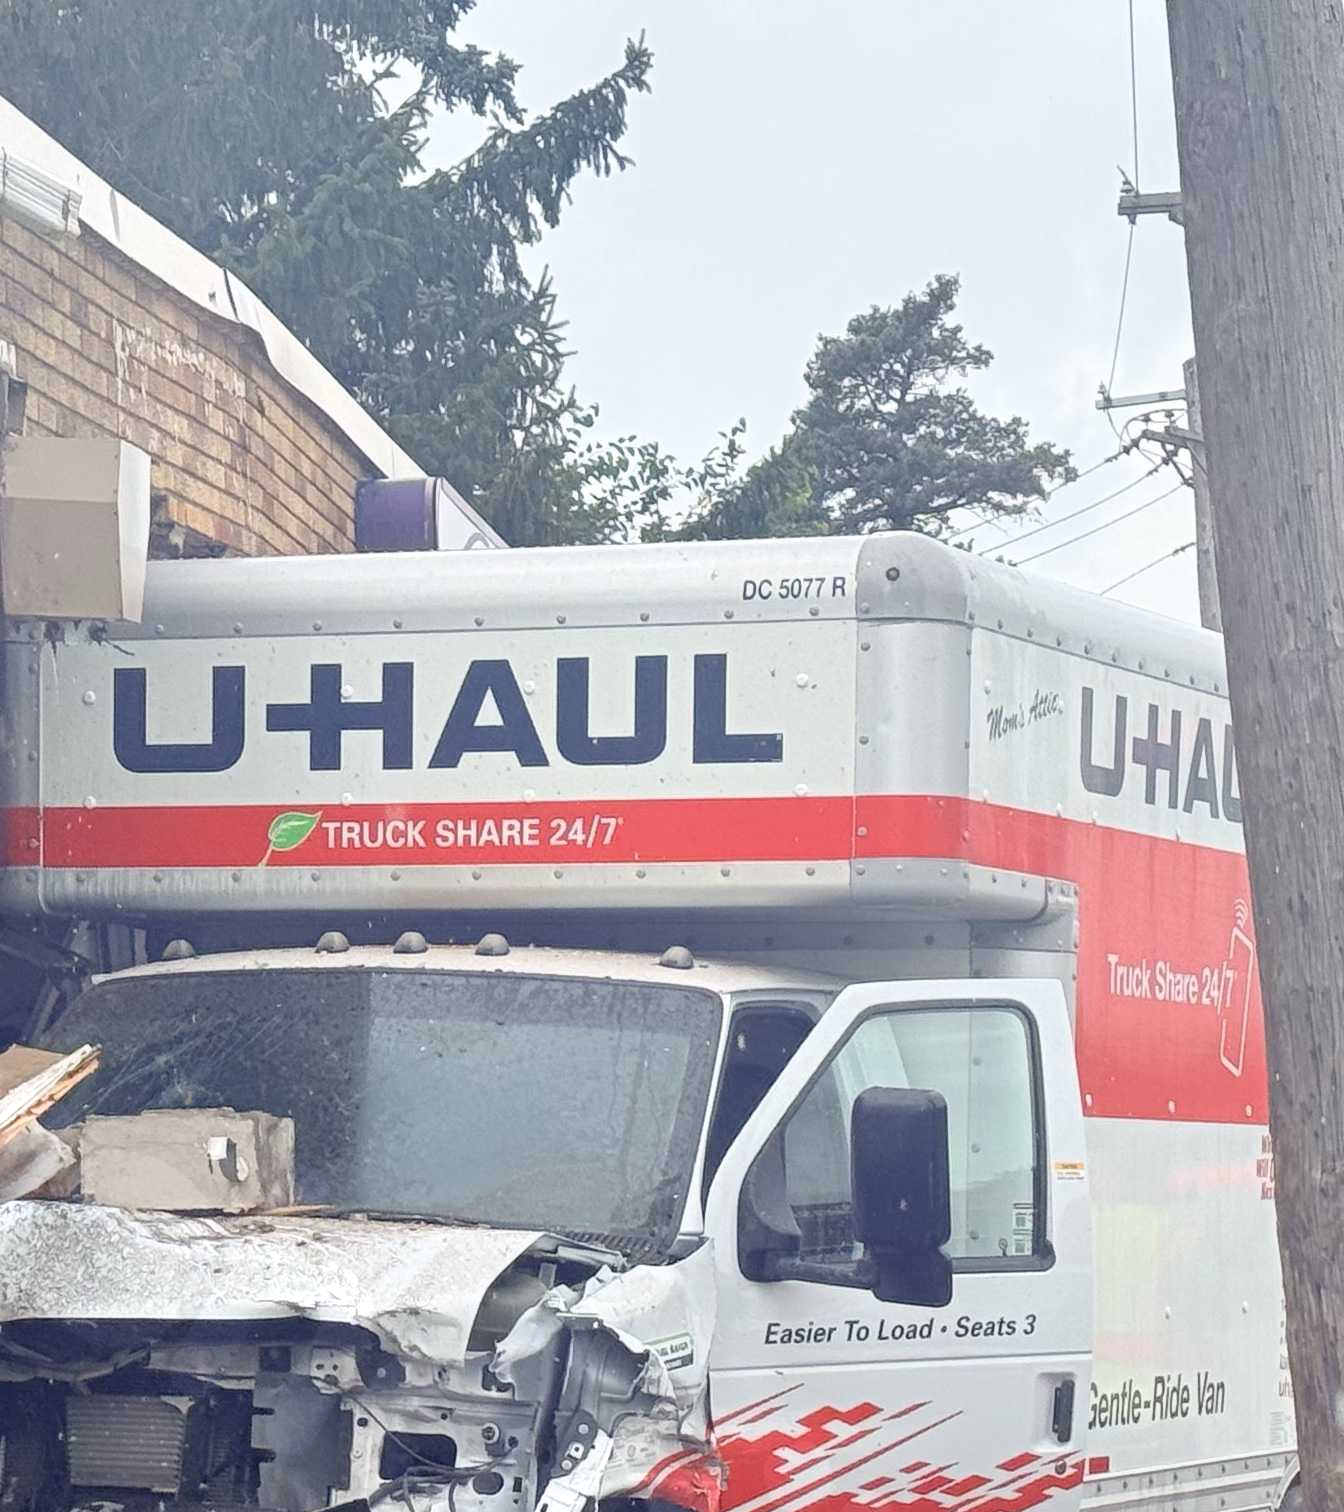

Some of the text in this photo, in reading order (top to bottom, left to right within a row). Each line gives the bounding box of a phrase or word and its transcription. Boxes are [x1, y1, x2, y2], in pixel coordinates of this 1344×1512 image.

[743, 576, 846, 600] DC 5077 R
[113, 653, 783, 773] U-HAUL
[987, 705, 1026, 742] Mom's
[322, 814, 617, 849] TRUCK SHARE 24/7
[1107, 953, 1235, 1015] Truck Share 24/7
[764, 1314, 1037, 1344] Easier To Load Seats 3
[1197, 1371, 1225, 1416] Van
